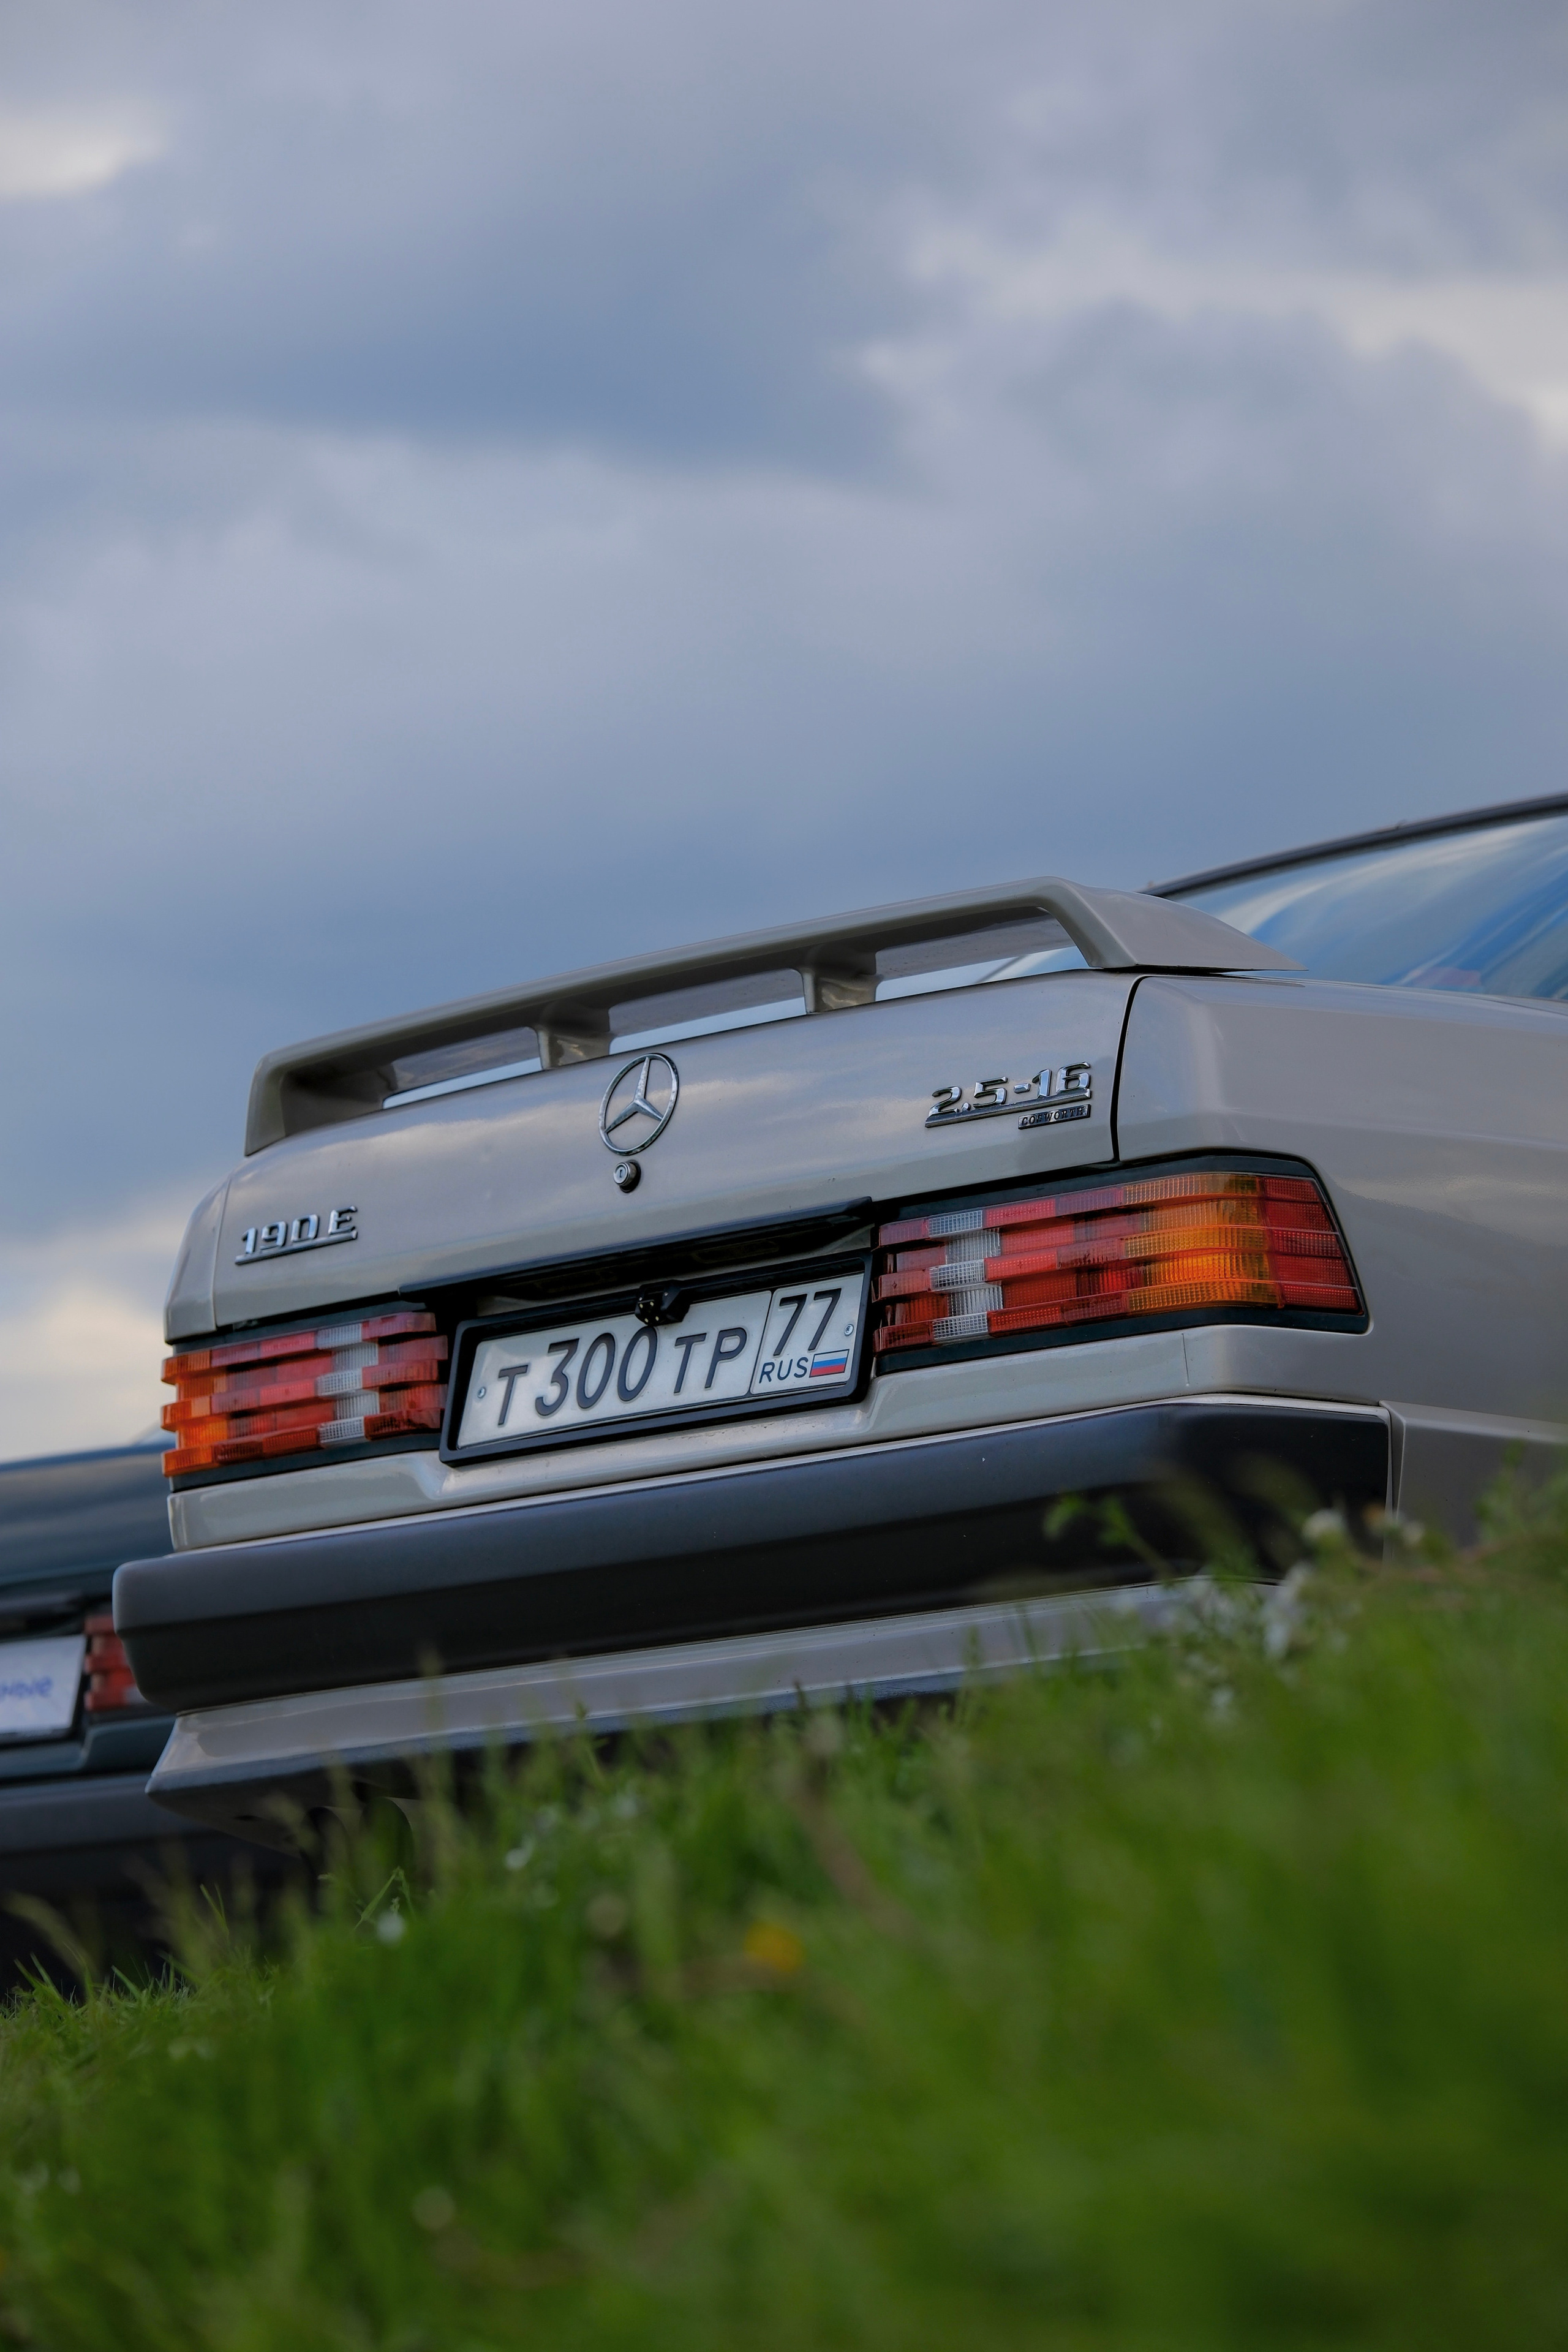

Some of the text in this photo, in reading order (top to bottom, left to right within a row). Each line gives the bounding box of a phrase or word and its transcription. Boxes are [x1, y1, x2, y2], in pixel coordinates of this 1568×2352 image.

[929, 1061, 1091, 1116] 2.5-16
[1021, 1106, 1085, 1126] COSWORTH
[241, 1205, 357, 1254] 190 E
[774, 1287, 842, 1357] 77
[759, 1356, 809, 1384] RUS
